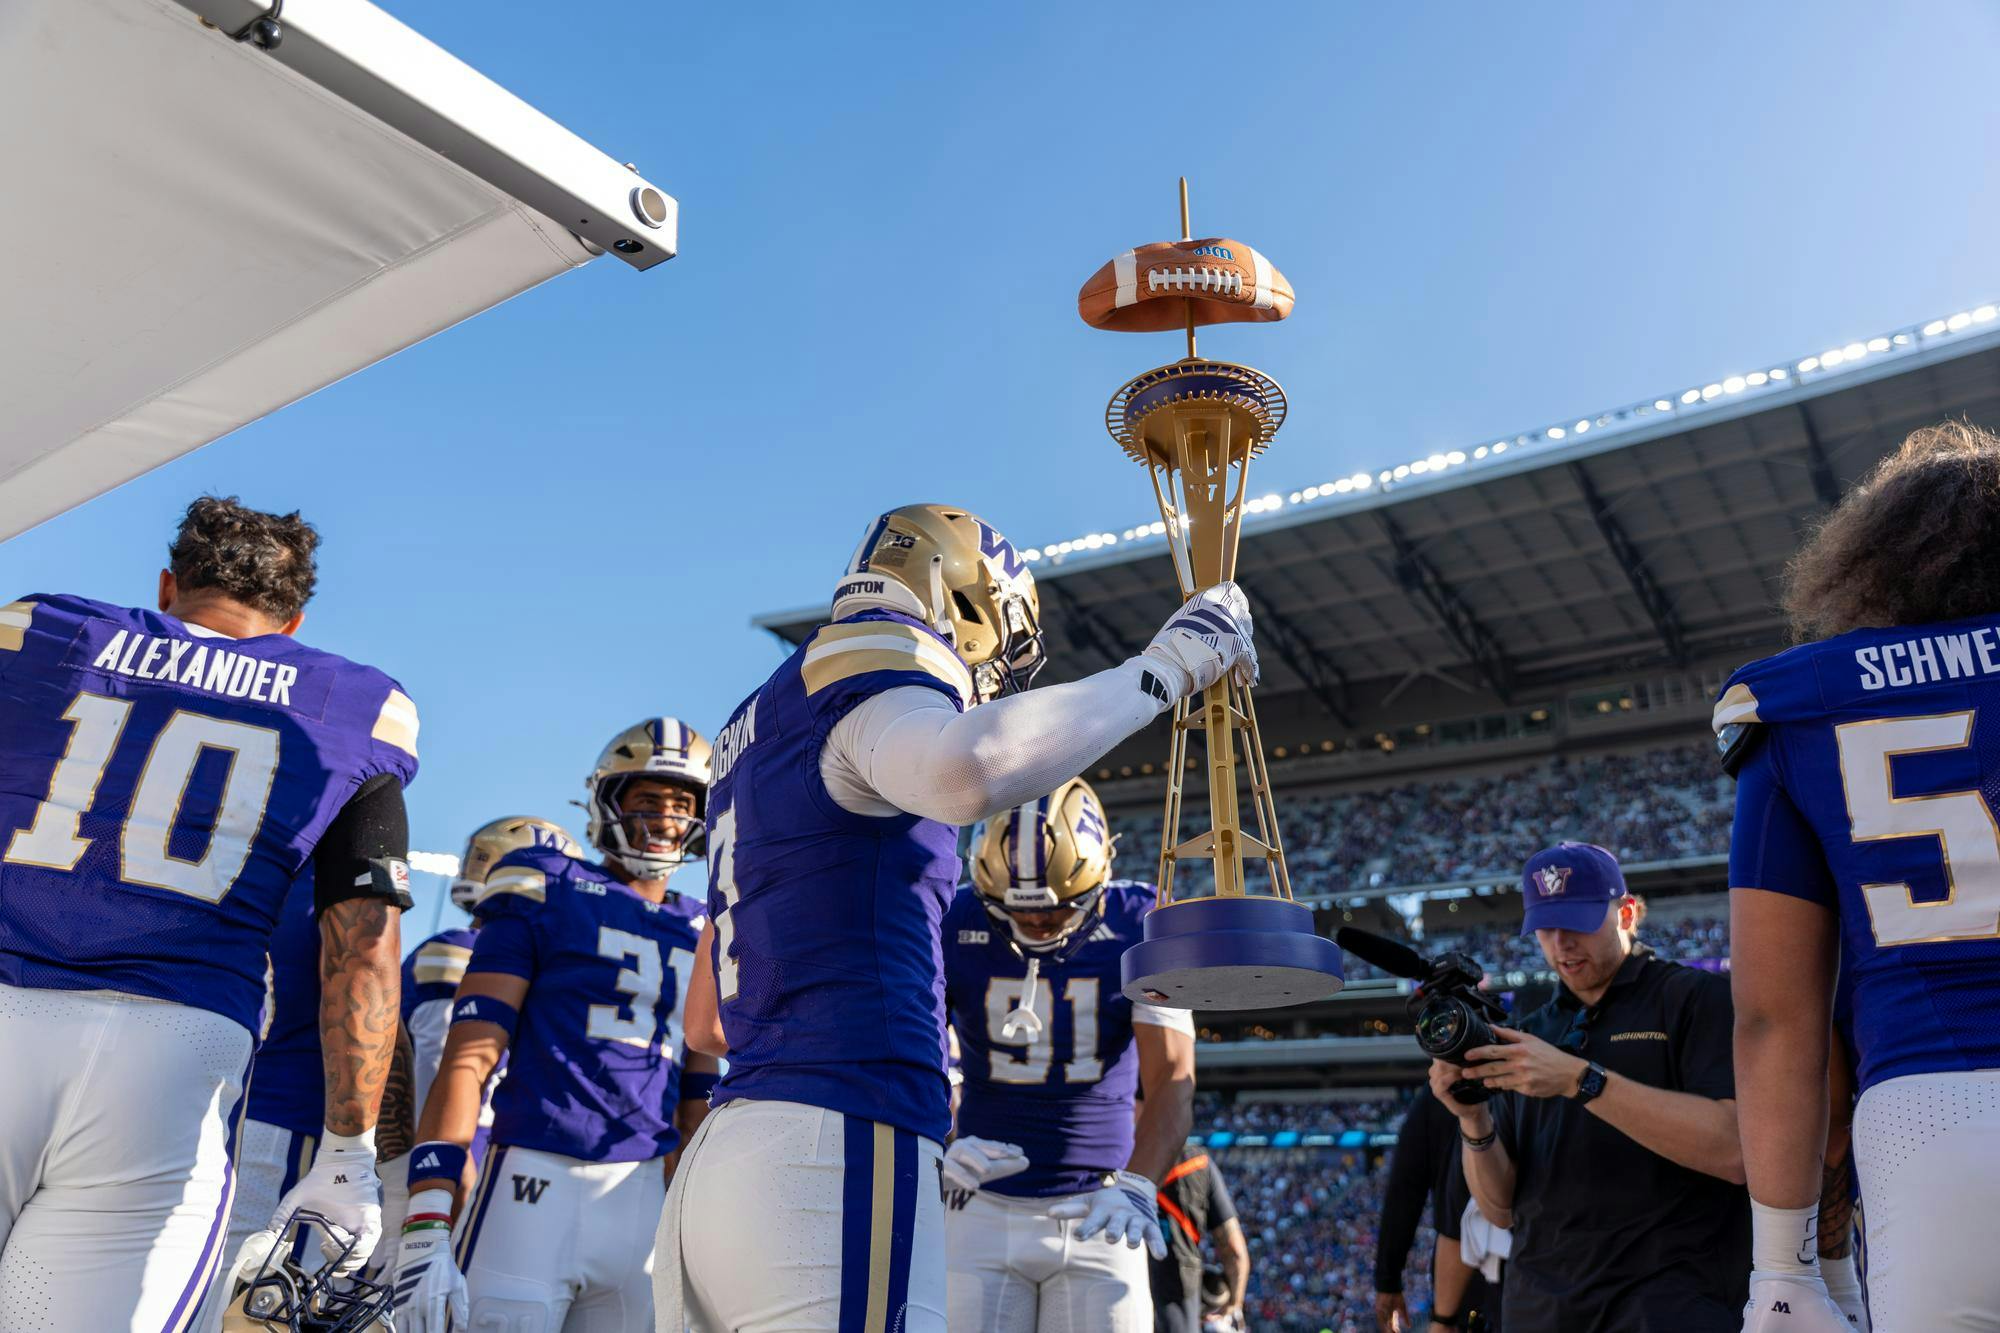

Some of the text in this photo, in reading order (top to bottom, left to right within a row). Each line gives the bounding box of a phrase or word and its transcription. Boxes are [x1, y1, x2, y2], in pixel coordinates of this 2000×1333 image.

[94, 629, 298, 706] ALEXANDER
[1855, 626, 2000, 690] SCHWE
[4, 692, 280, 904] 10
[1834, 706, 2000, 947] 5
[586, 925, 698, 1063] 31
[984, 976, 1104, 1085] 91
[1610, 1031, 1668, 1042] WASHINGTON
[512, 1173, 551, 1205] W
